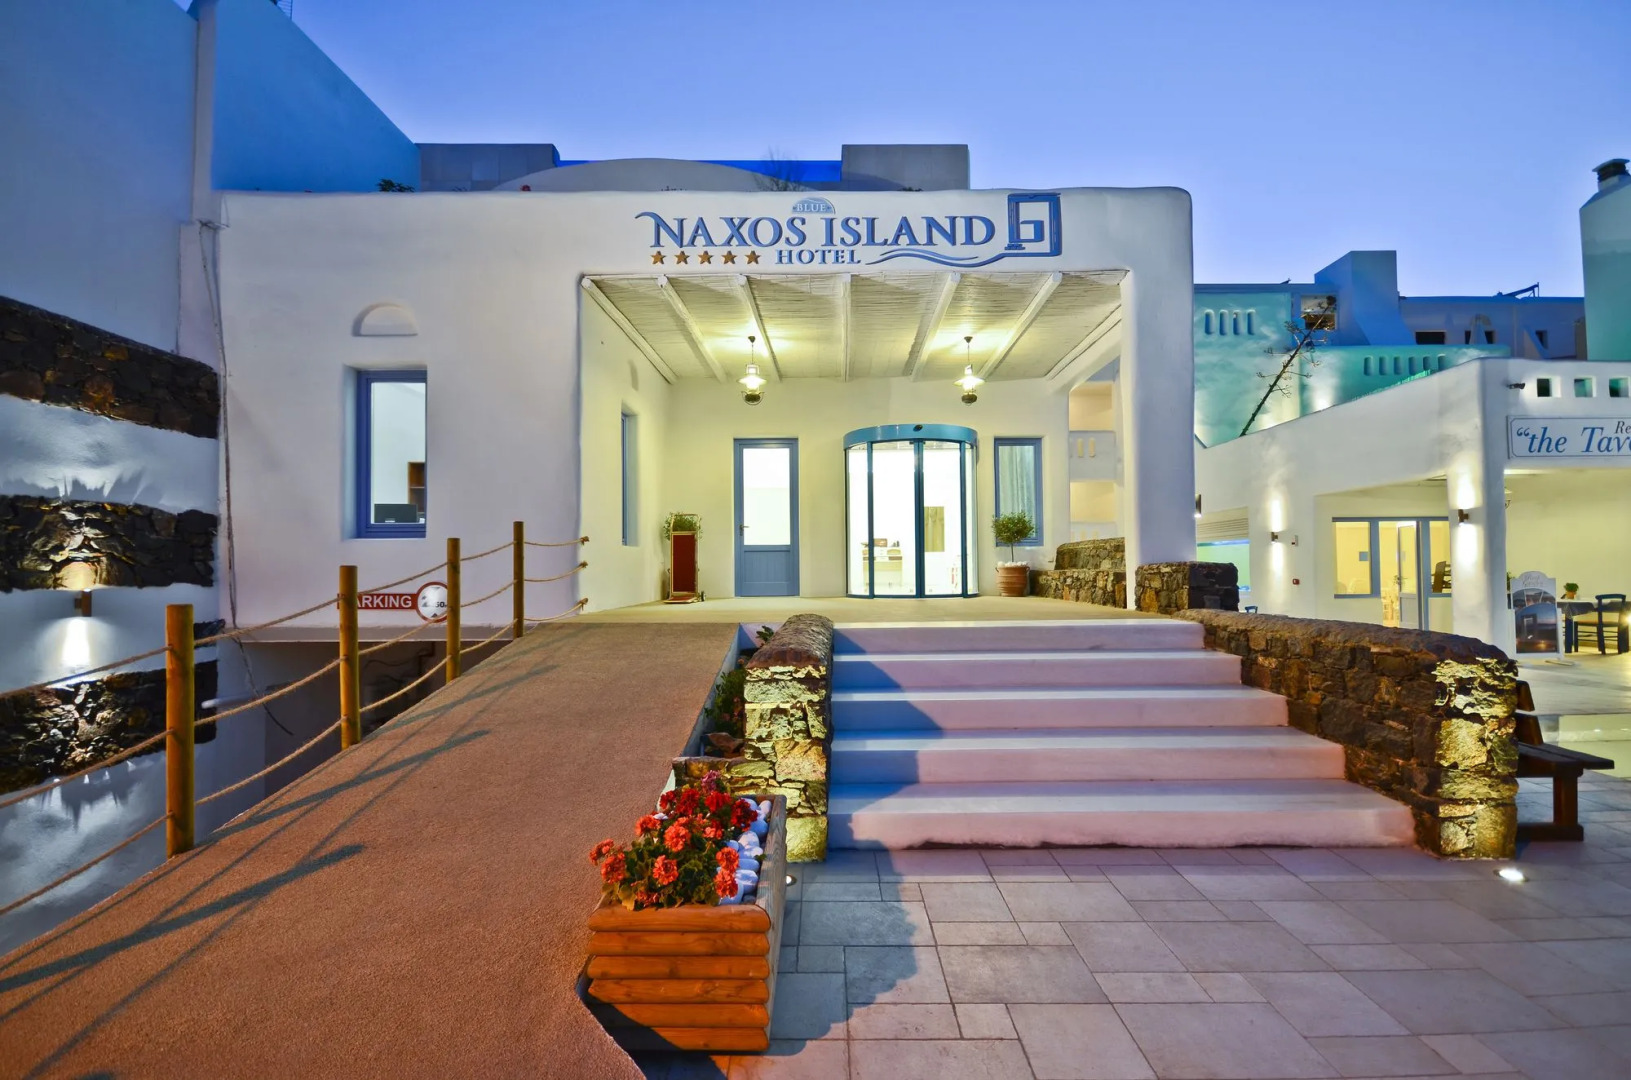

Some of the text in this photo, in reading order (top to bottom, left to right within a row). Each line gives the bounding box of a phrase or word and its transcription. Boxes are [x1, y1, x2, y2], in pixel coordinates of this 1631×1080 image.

[796, 203, 827, 212] BLUE
[635, 211, 996, 248] NAXOS ISLAND
[774, 249, 861, 265] HOTEL
[1581, 426, 1631, 453] Tav
[357, 595, 412, 608] RKING
